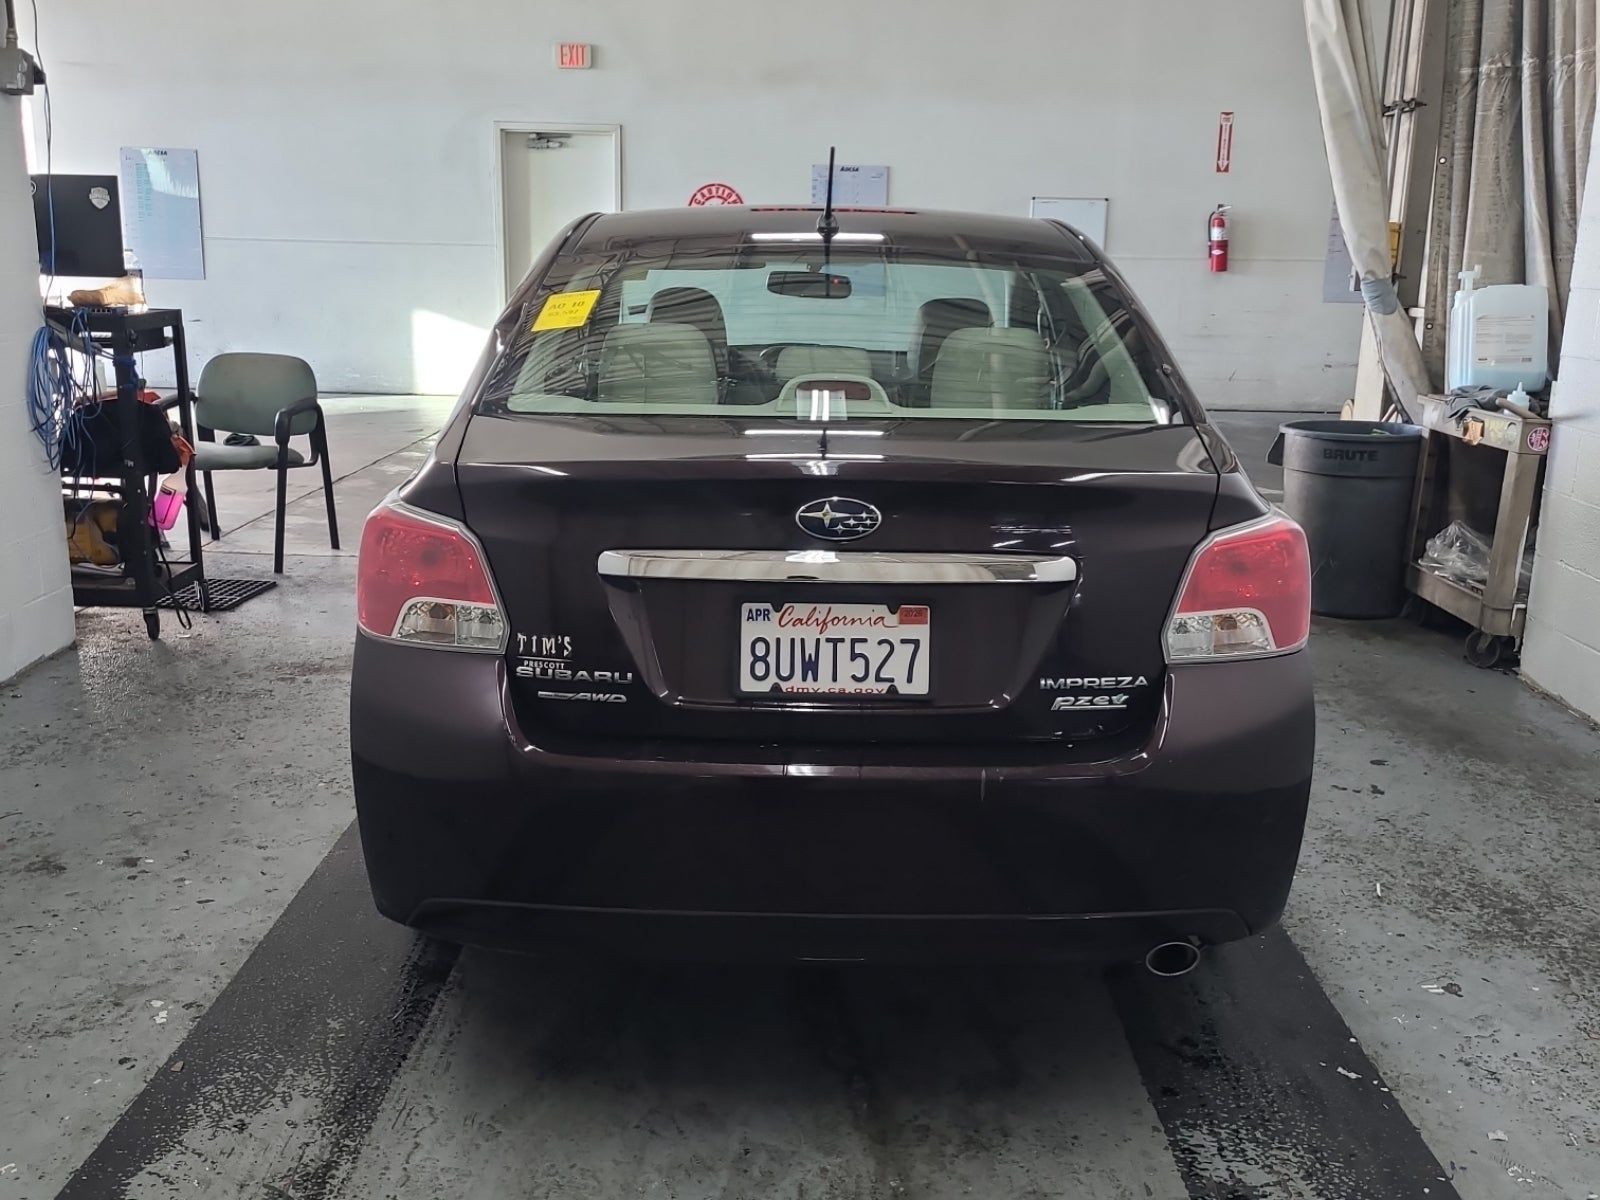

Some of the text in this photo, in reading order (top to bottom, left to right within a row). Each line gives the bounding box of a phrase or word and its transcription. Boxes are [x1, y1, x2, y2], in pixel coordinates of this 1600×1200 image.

[560, 44, 586, 66] EXIT
[694, 186, 740, 205] CAUTION
[1323, 449, 1377, 461] BRUTE
[747, 605, 898, 634] APR California
[517, 633, 572, 656] TIM'S
[524, 661, 565, 669] PRESCOTT
[750, 637, 920, 684] 8UWT527
[516, 667, 632, 683] SUBARU
[1040, 676, 1148, 689] IMPREZA
[571, 693, 627, 703] AWD
